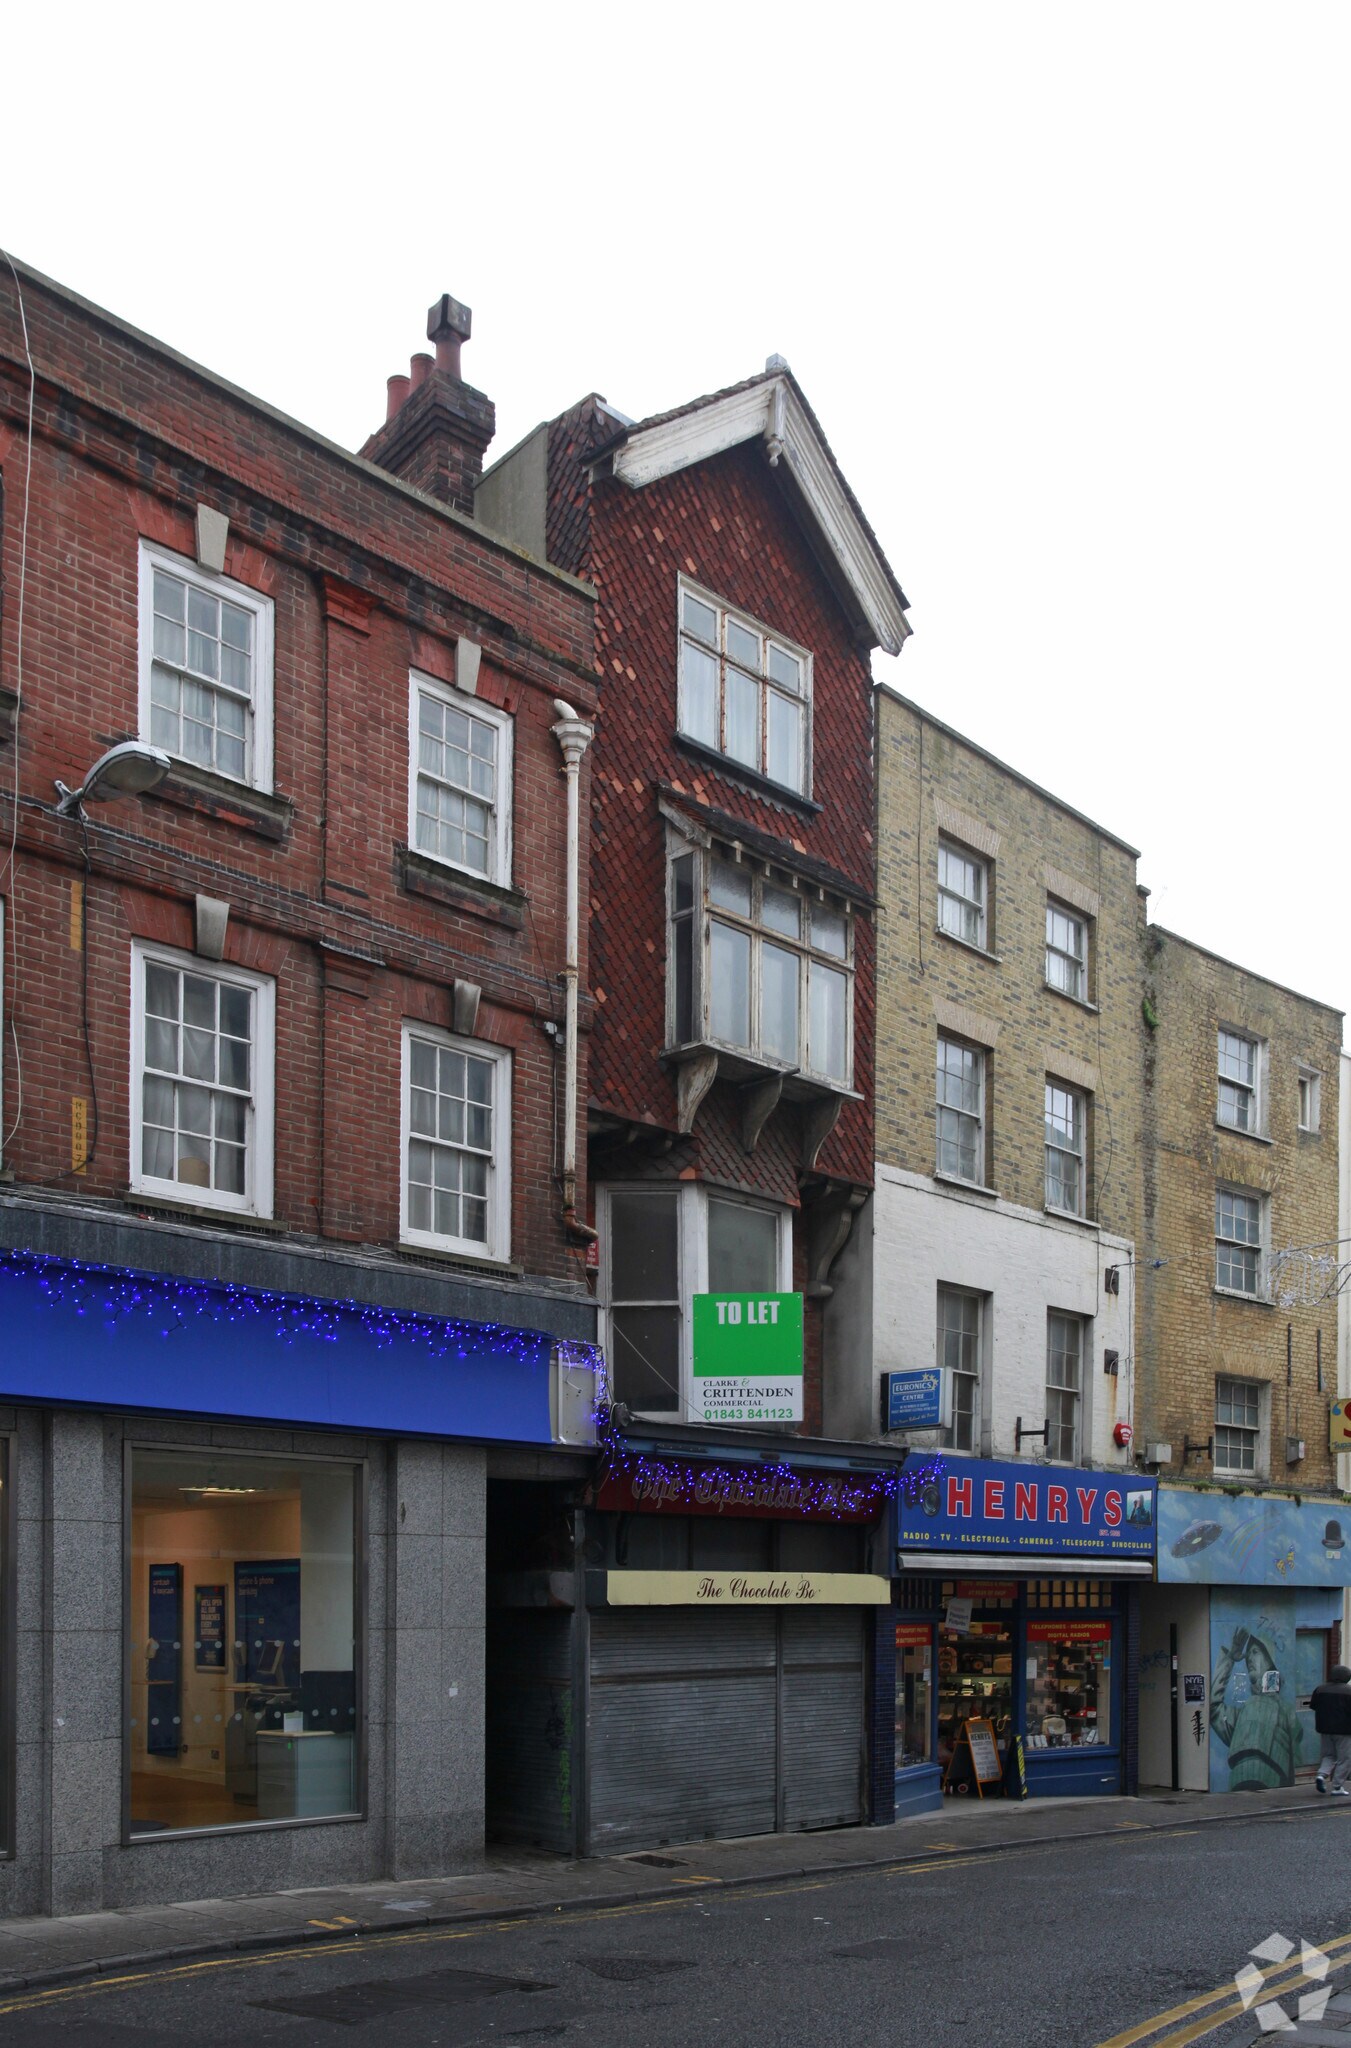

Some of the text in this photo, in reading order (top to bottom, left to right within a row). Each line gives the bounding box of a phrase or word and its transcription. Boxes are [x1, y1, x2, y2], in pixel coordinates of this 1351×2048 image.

[716, 1301, 780, 1325] TO LET
[703, 1388, 794, 1398] CRITTENDEN
[895, 1381, 932, 1392] EURONICS
[704, 1408, 793, 1419] 01843 841123
[695, 1468, 811, 1512] Chocolate
[946, 1476, 1123, 1527] HENRYS
[903, 1532, 1152, 1549] RADIO TV ELECTRICAL CAMERAS TELESCOPES BINOCULARS
[697, 1577, 820, 1599] The Chocolate Bo
[1185, 1676, 1203, 1684] NYE
